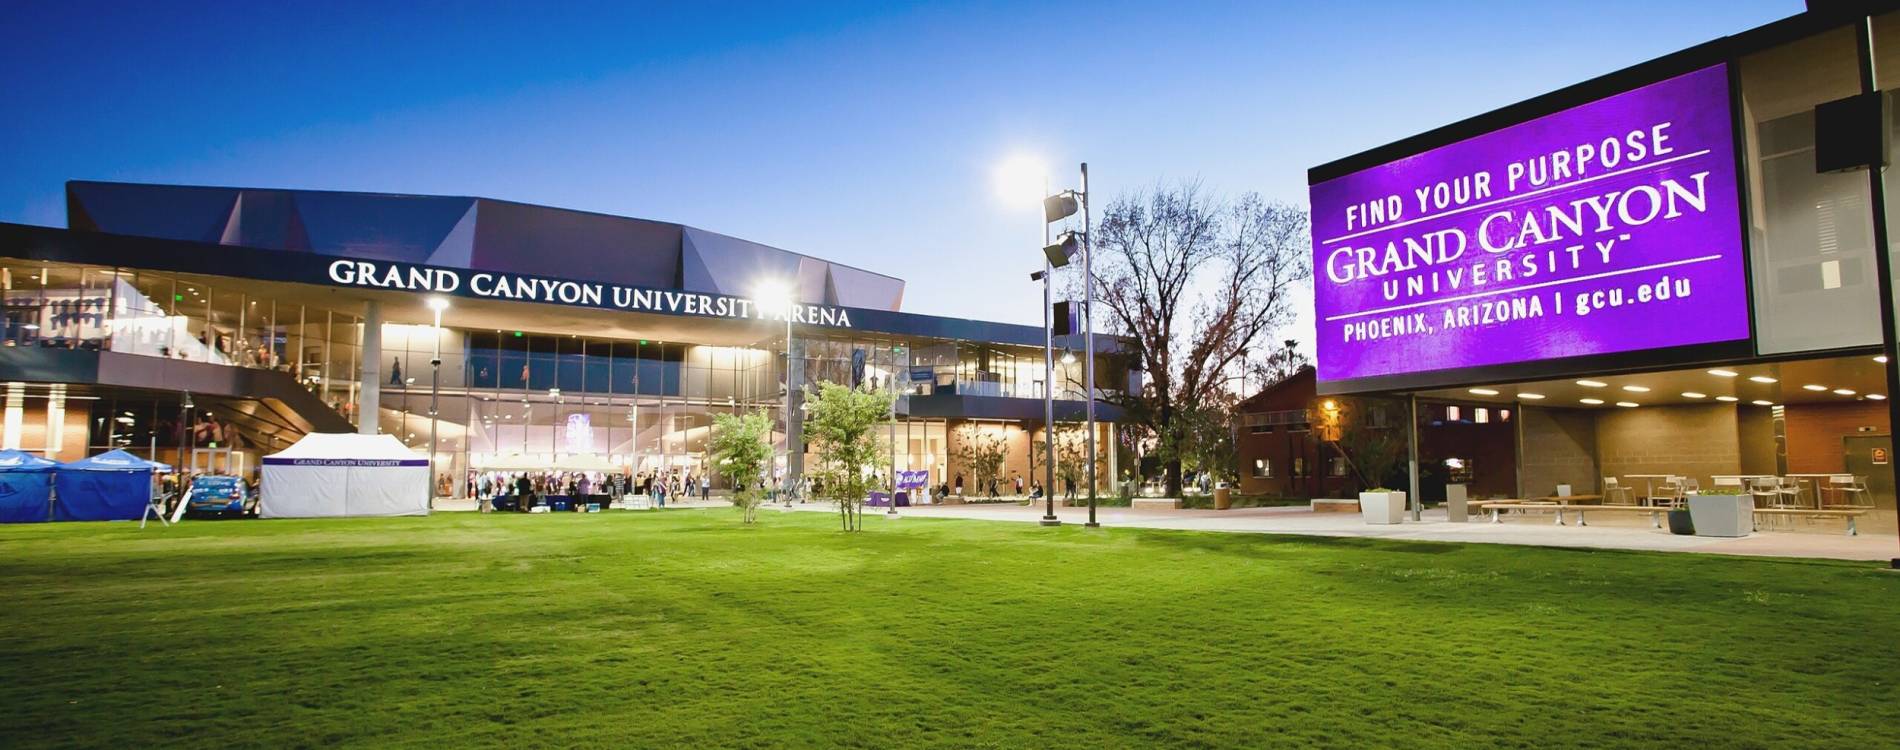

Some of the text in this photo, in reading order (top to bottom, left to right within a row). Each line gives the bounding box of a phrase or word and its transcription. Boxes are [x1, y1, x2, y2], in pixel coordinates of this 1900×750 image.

[1346, 122, 1673, 231] FIND YOUR PURPOSE
[1326, 171, 1710, 284] GRAND CANYON
[328, 260, 460, 293] GRAND
[470, 273, 603, 305] CANYON
[1383, 239, 1615, 301] UNIVERSITY
[1343, 313, 1436, 343] PHOENIX,
[1443, 296, 1544, 329] ARIZONA
[1576, 275, 1692, 316] gcu.edu
